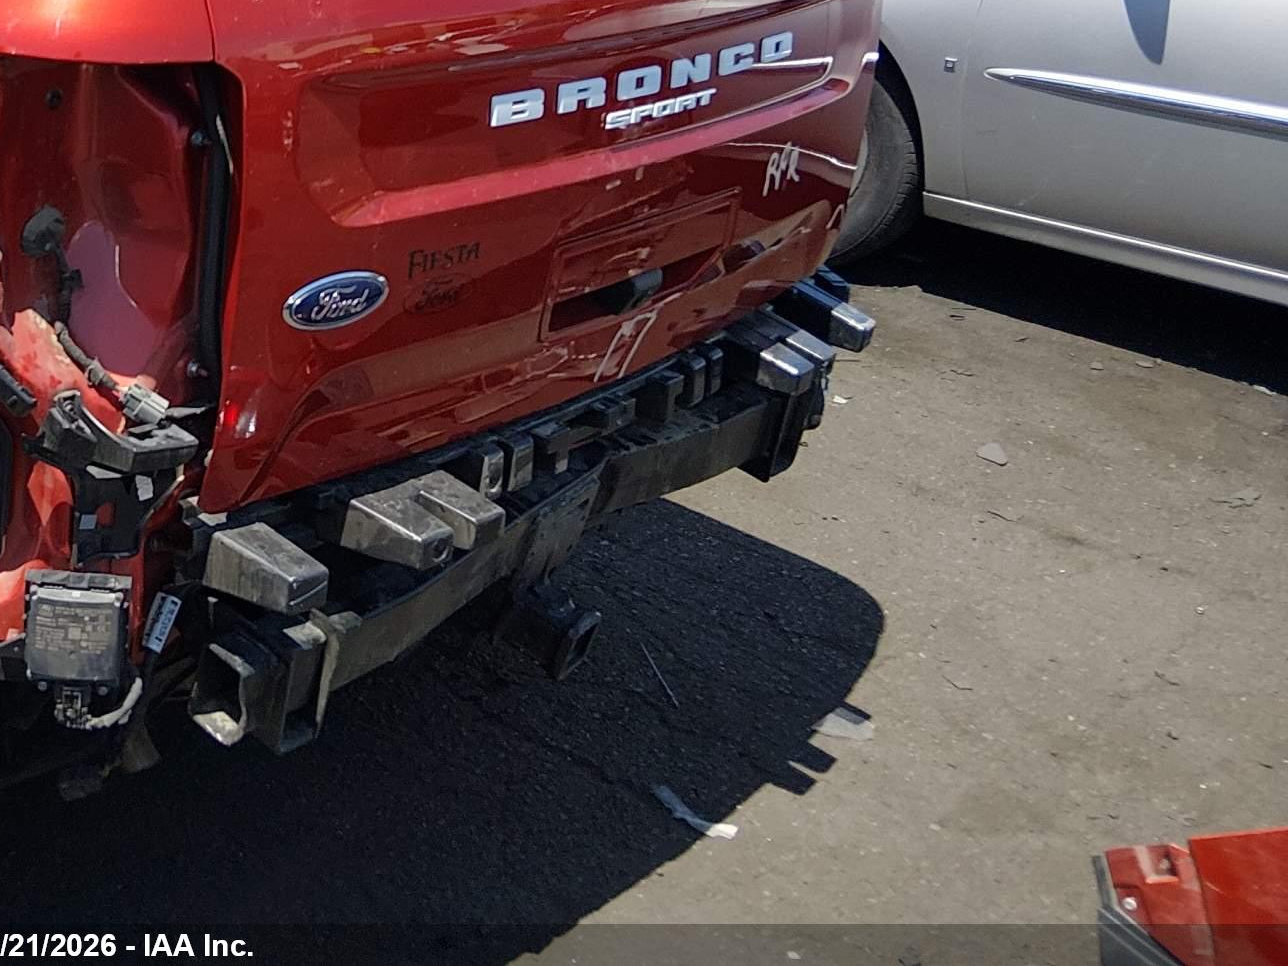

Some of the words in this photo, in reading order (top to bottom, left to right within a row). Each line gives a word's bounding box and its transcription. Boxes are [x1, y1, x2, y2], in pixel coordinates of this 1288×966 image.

[489, 30, 794, 128] BRONCO
[603, 89, 717, 130] SPORT
[310, 284, 370, 321] Ford
